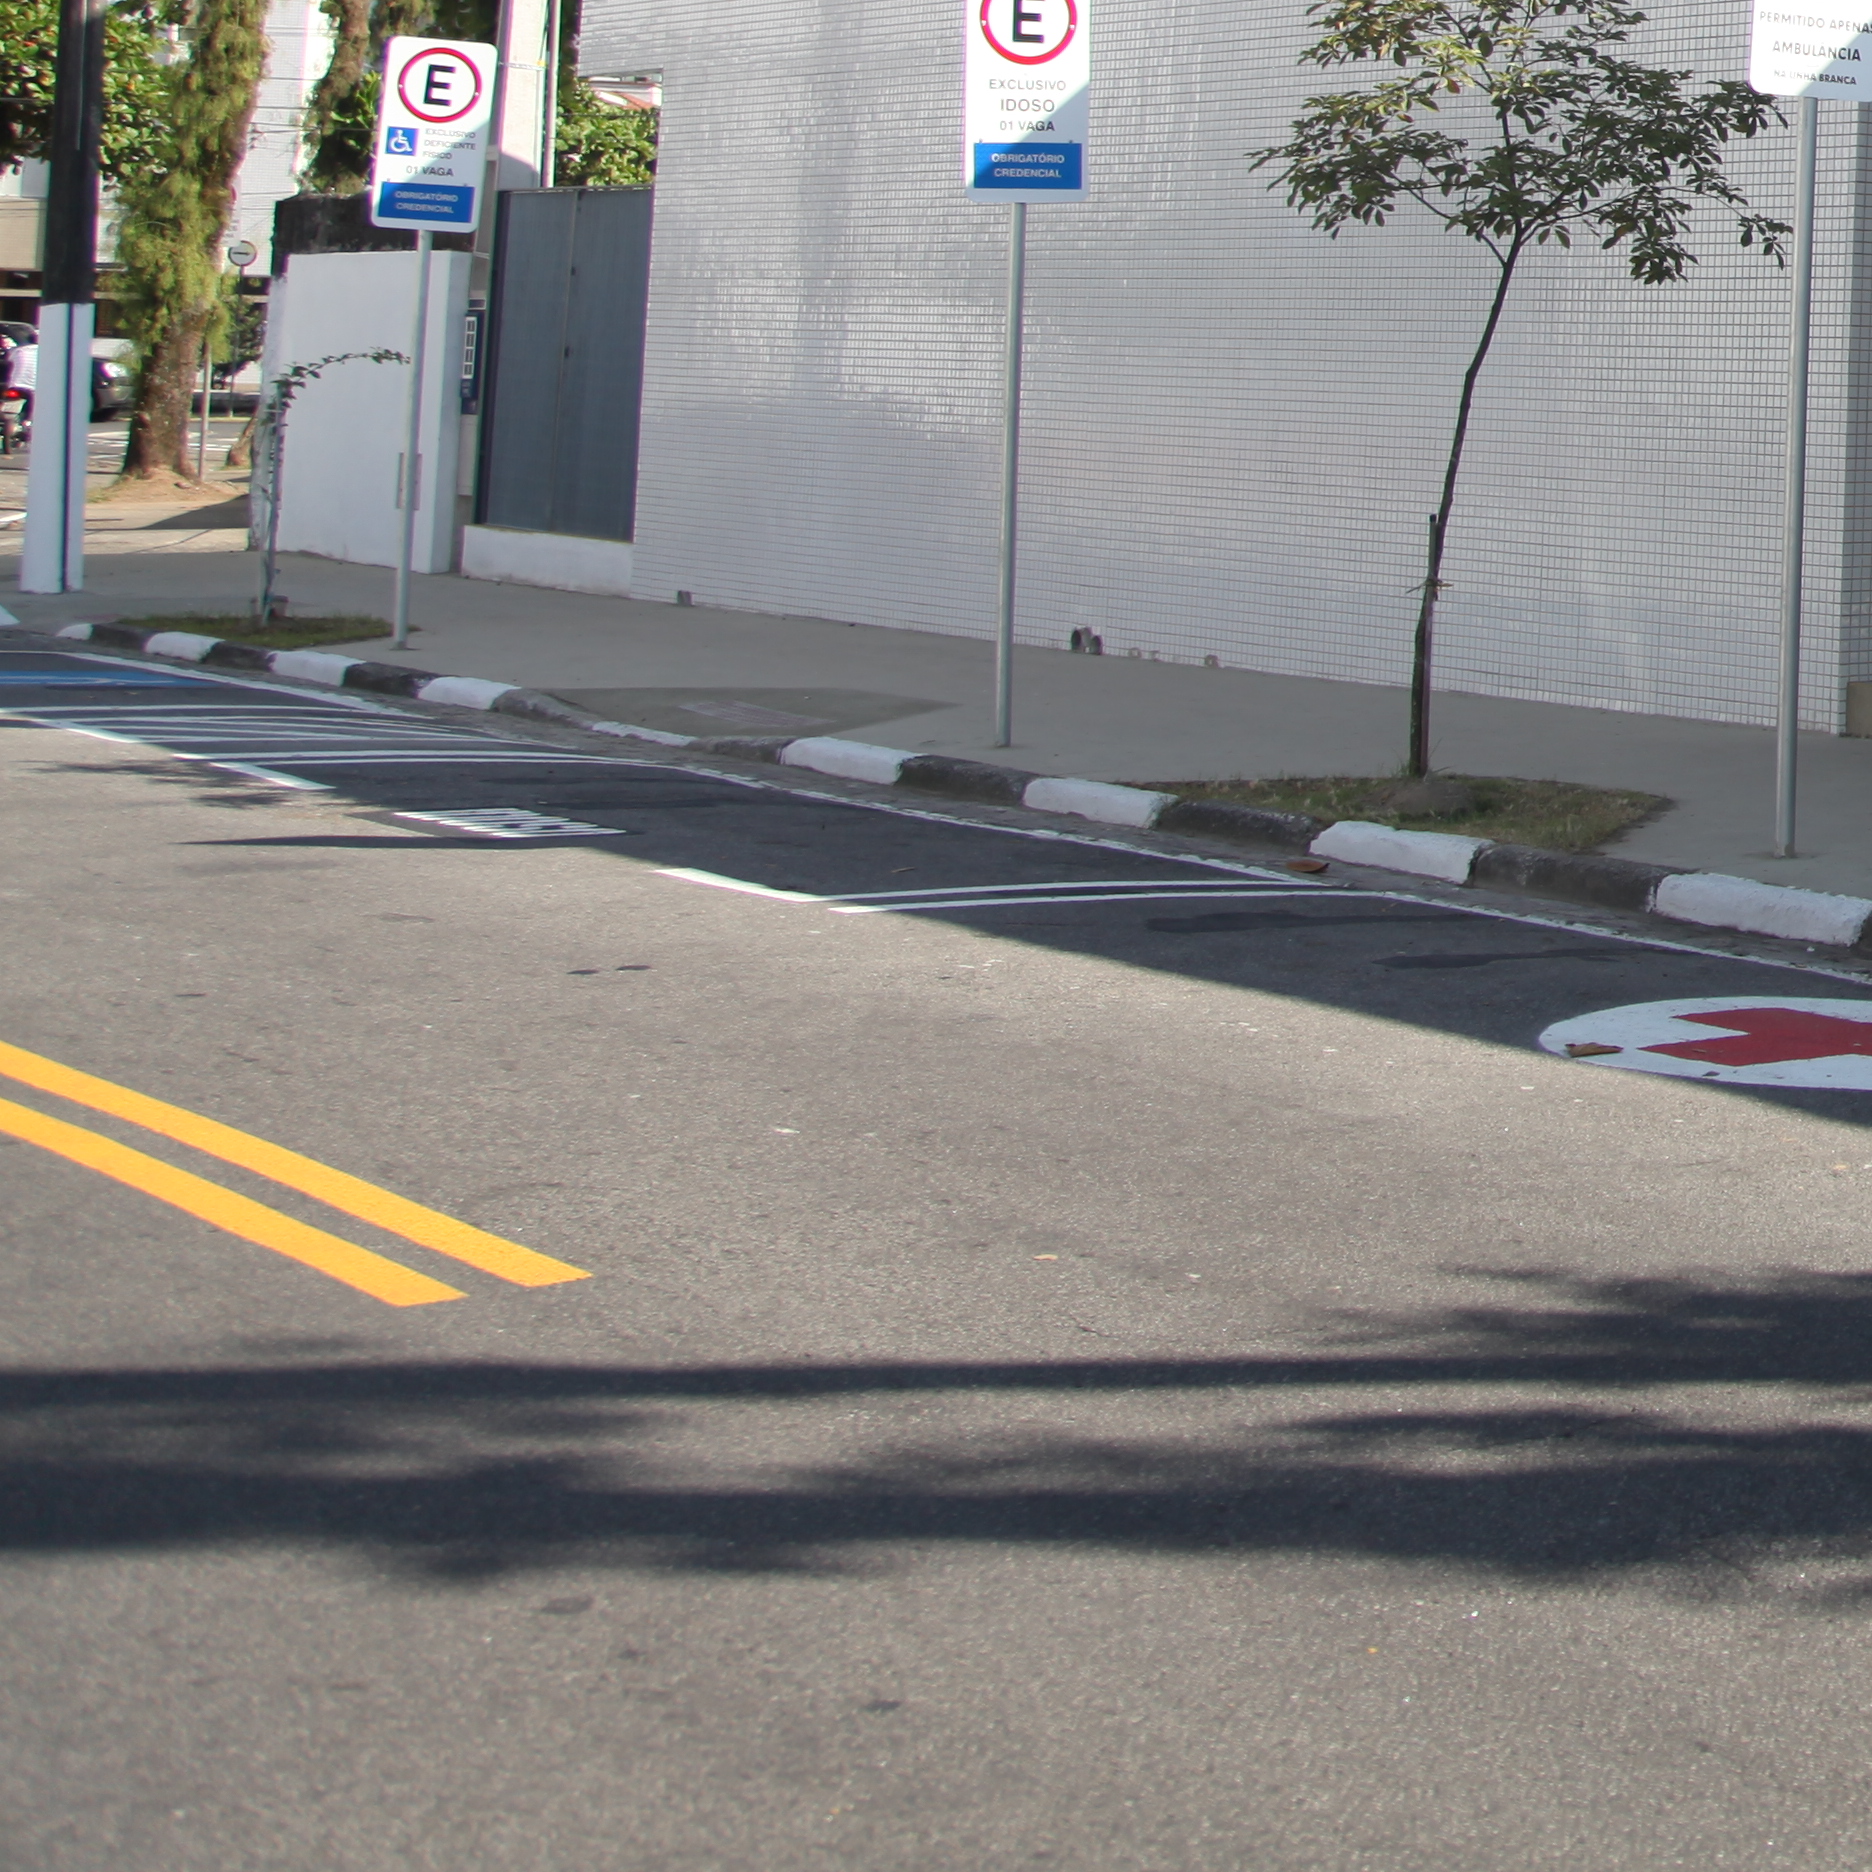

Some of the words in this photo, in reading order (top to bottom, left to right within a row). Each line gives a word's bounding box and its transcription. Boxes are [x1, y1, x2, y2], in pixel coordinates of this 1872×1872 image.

[1759, 10, 1825, 29] PERMITIDO
[1774, 69, 1785, 78] NA
[1789, 71, 1817, 83] LINHA
[1818, 72, 1857, 86] BRANCA
[424, 64, 456, 106] E
[988, 78, 1067, 91] EXCLUSIVO
[1000, 98, 1055, 113] IDOSO
[999, 120, 1014, 131] 01
[1018, 120, 1056, 132] VAGA
[426, 128, 476, 138] EXCLUSIVO
[424, 140, 476, 150] DEFICIENTE
[990, 152, 1065, 164] OBRIGATÓRIO
[405, 165, 419, 175] 01
[422, 166, 454, 176] VAGA
[993, 167, 1062, 179] CREDENCIAL
[396, 202, 454, 213] CREDENCIAL
